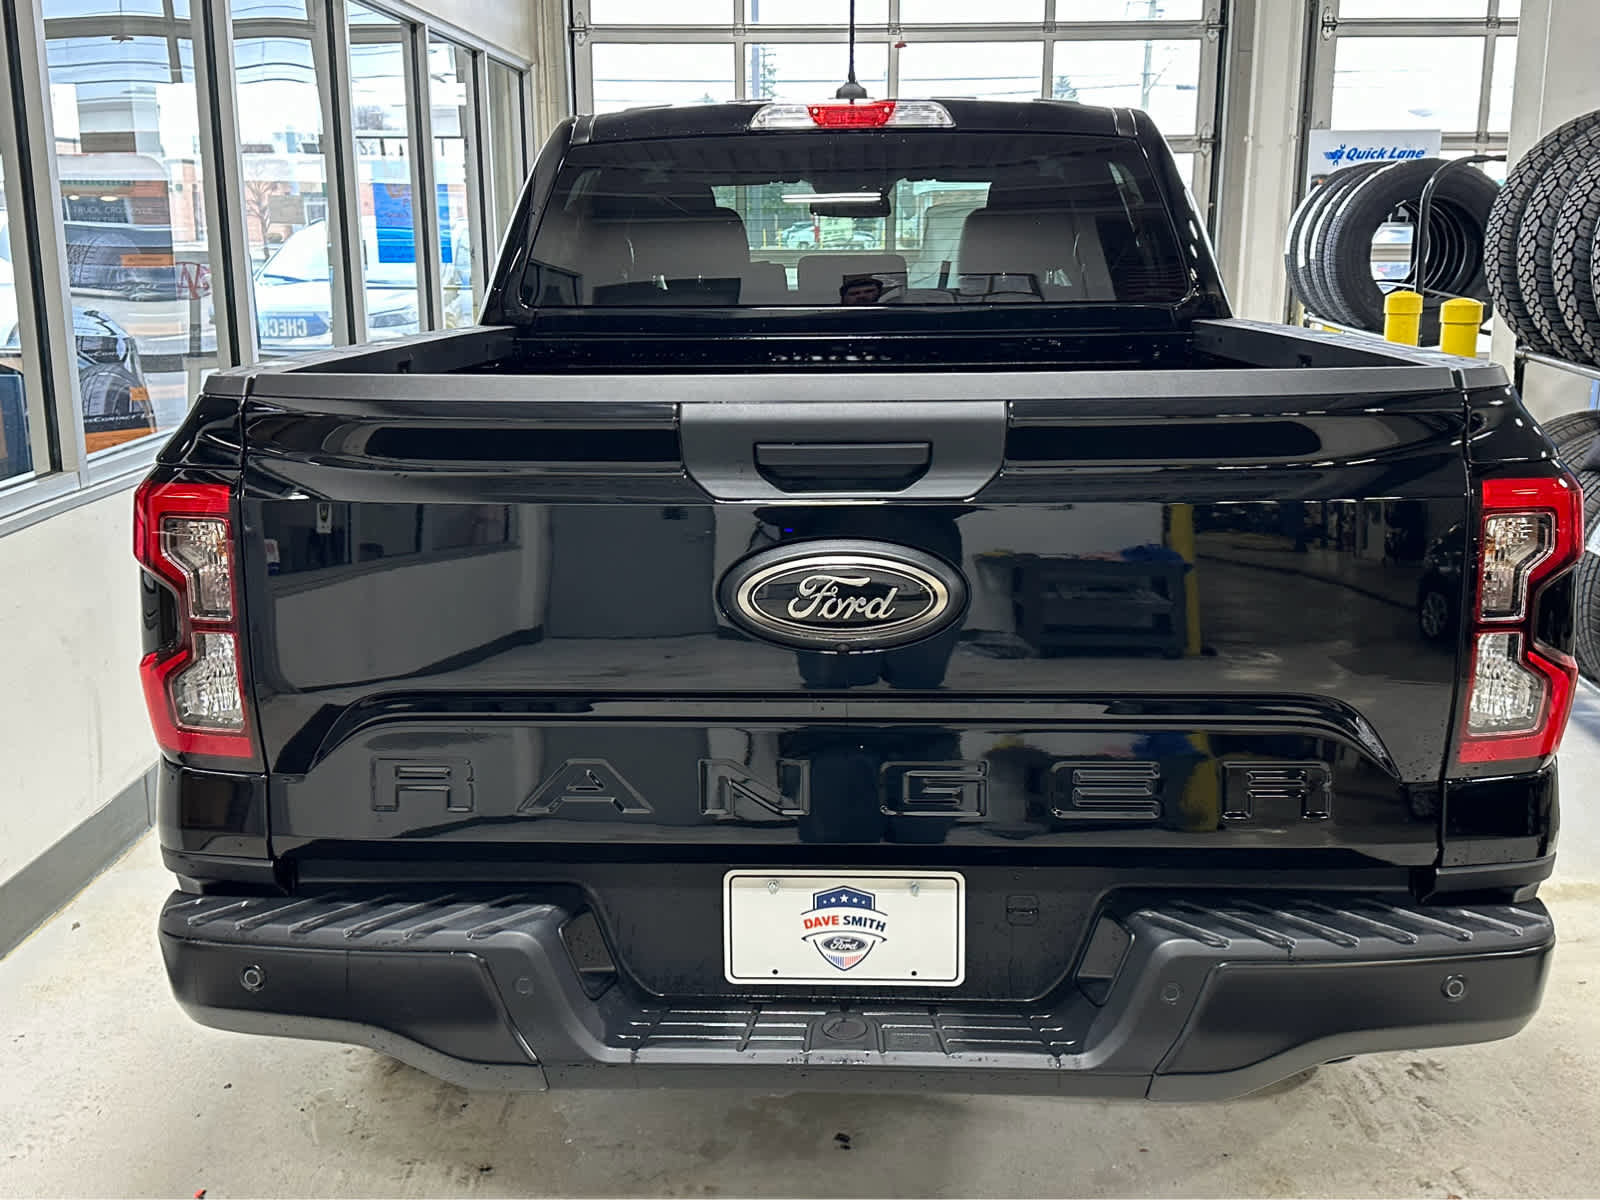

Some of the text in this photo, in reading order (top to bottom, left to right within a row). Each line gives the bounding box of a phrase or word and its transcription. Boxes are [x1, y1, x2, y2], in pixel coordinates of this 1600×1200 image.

[1346, 147, 1425, 161] Quick Lane
[787, 574, 899, 619] Ford
[370, 757, 1332, 820] RANGER
[803, 915, 887, 933] DAVE SMITH
[829, 936, 859, 951] Ford
